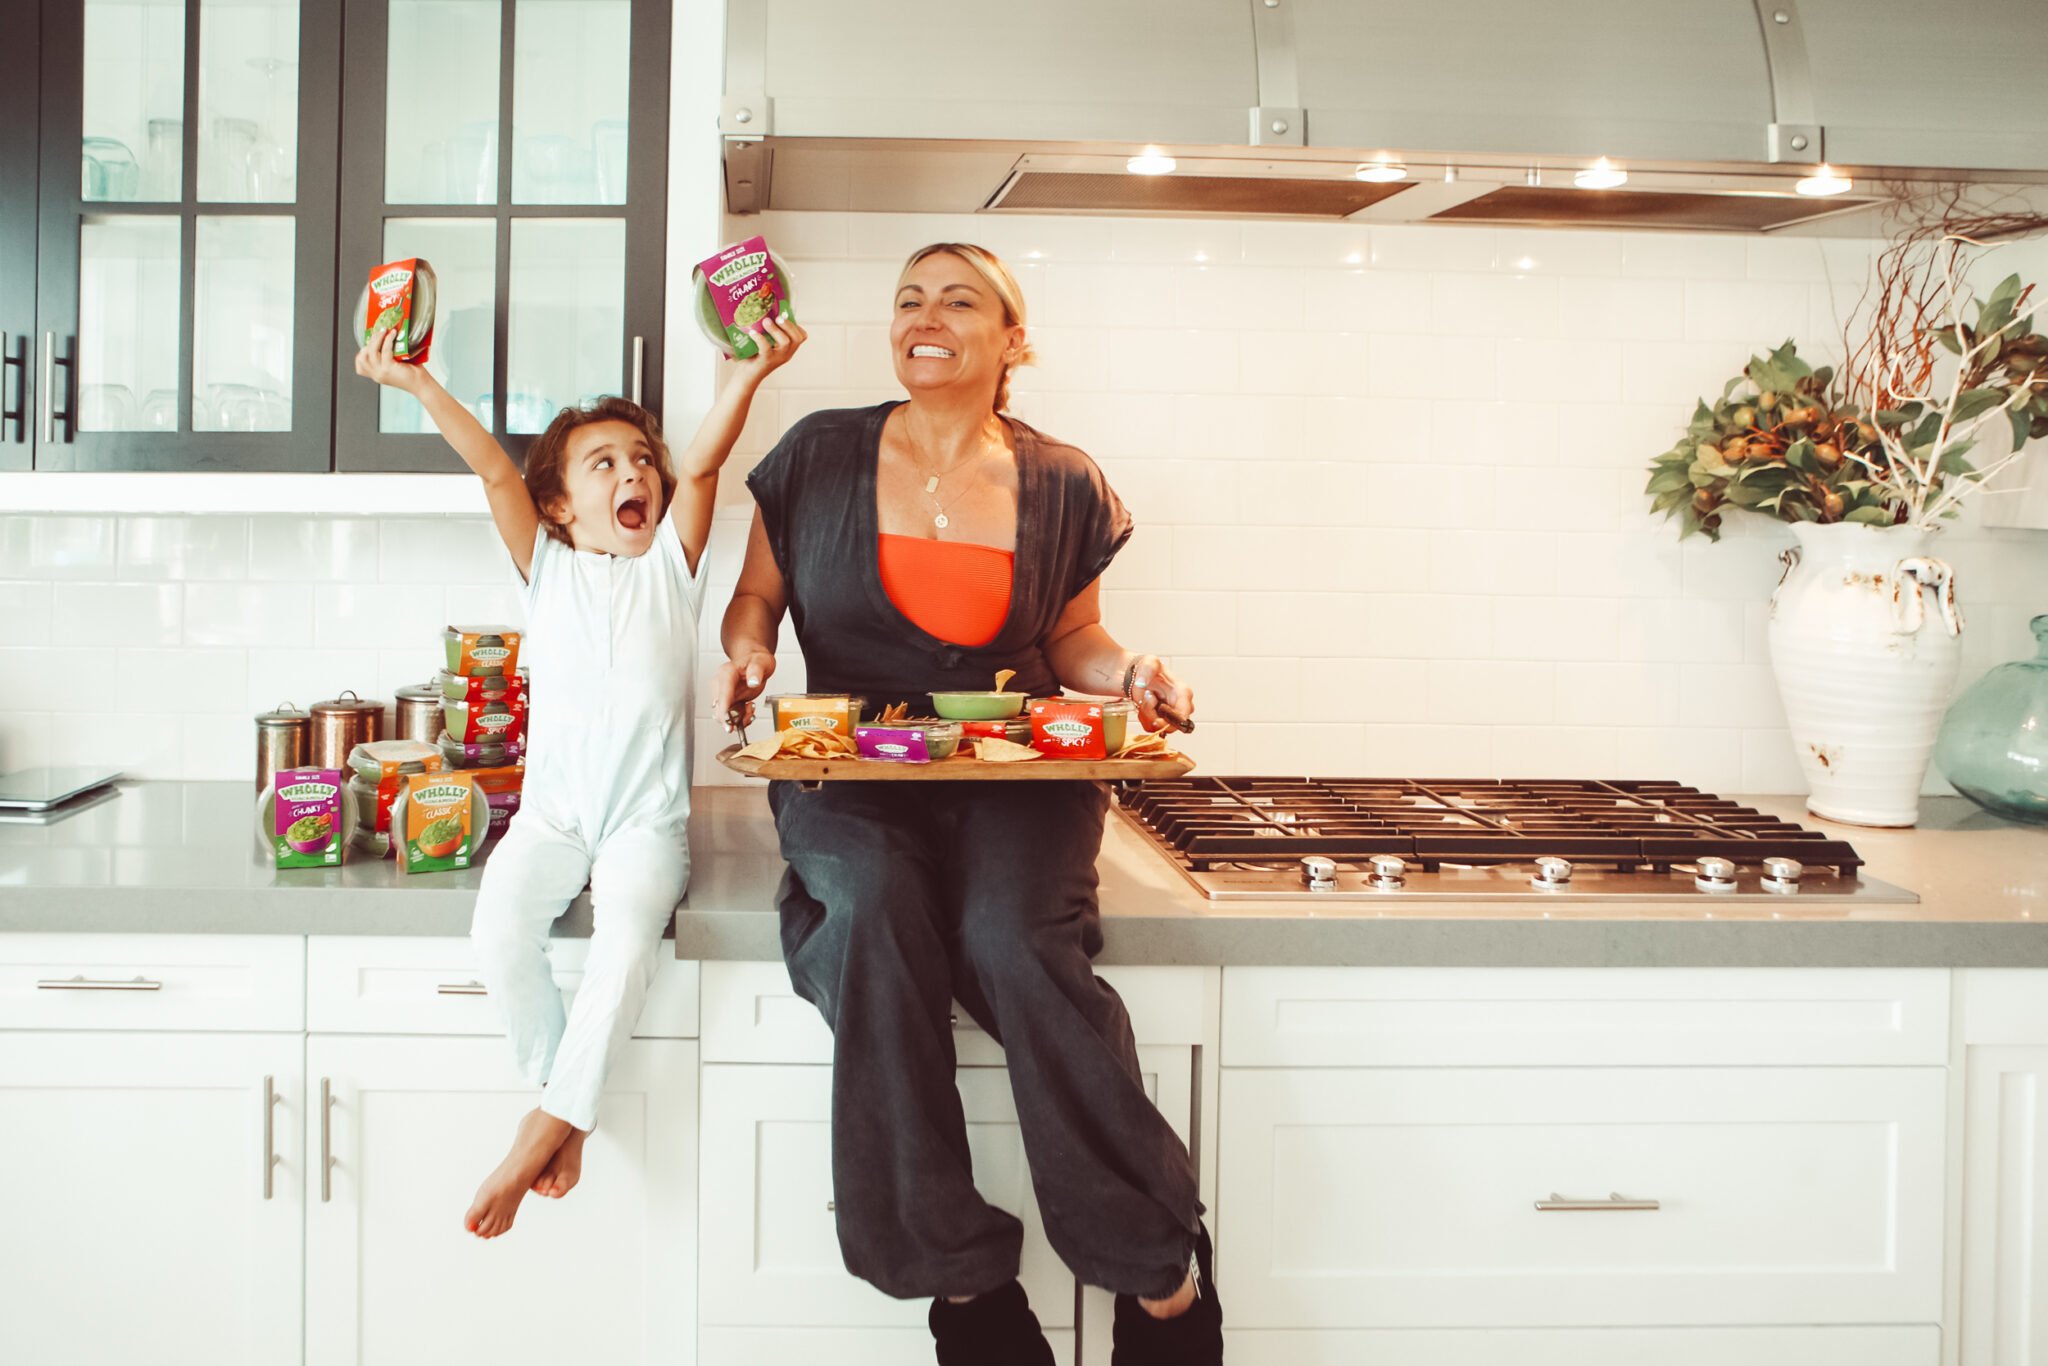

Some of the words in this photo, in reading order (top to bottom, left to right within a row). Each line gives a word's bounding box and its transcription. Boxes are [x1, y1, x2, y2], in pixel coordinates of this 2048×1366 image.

[712, 253, 765, 283] WHOLLY
[373, 271, 411, 289] WHOLLY
[732, 278, 758, 301] CHUNKY
[472, 648, 509, 657] WHOLLY
[478, 715, 514, 724] WHOLLY
[1045, 723, 1091, 734] WHOLLY
[1061, 737, 1086, 748] SPICY
[281, 784, 336, 798] WHOLLY
[415, 786, 468, 801] WHOLLY
[293, 805, 321, 817] CHUNKY
[426, 806, 453, 819] CLASSIC
